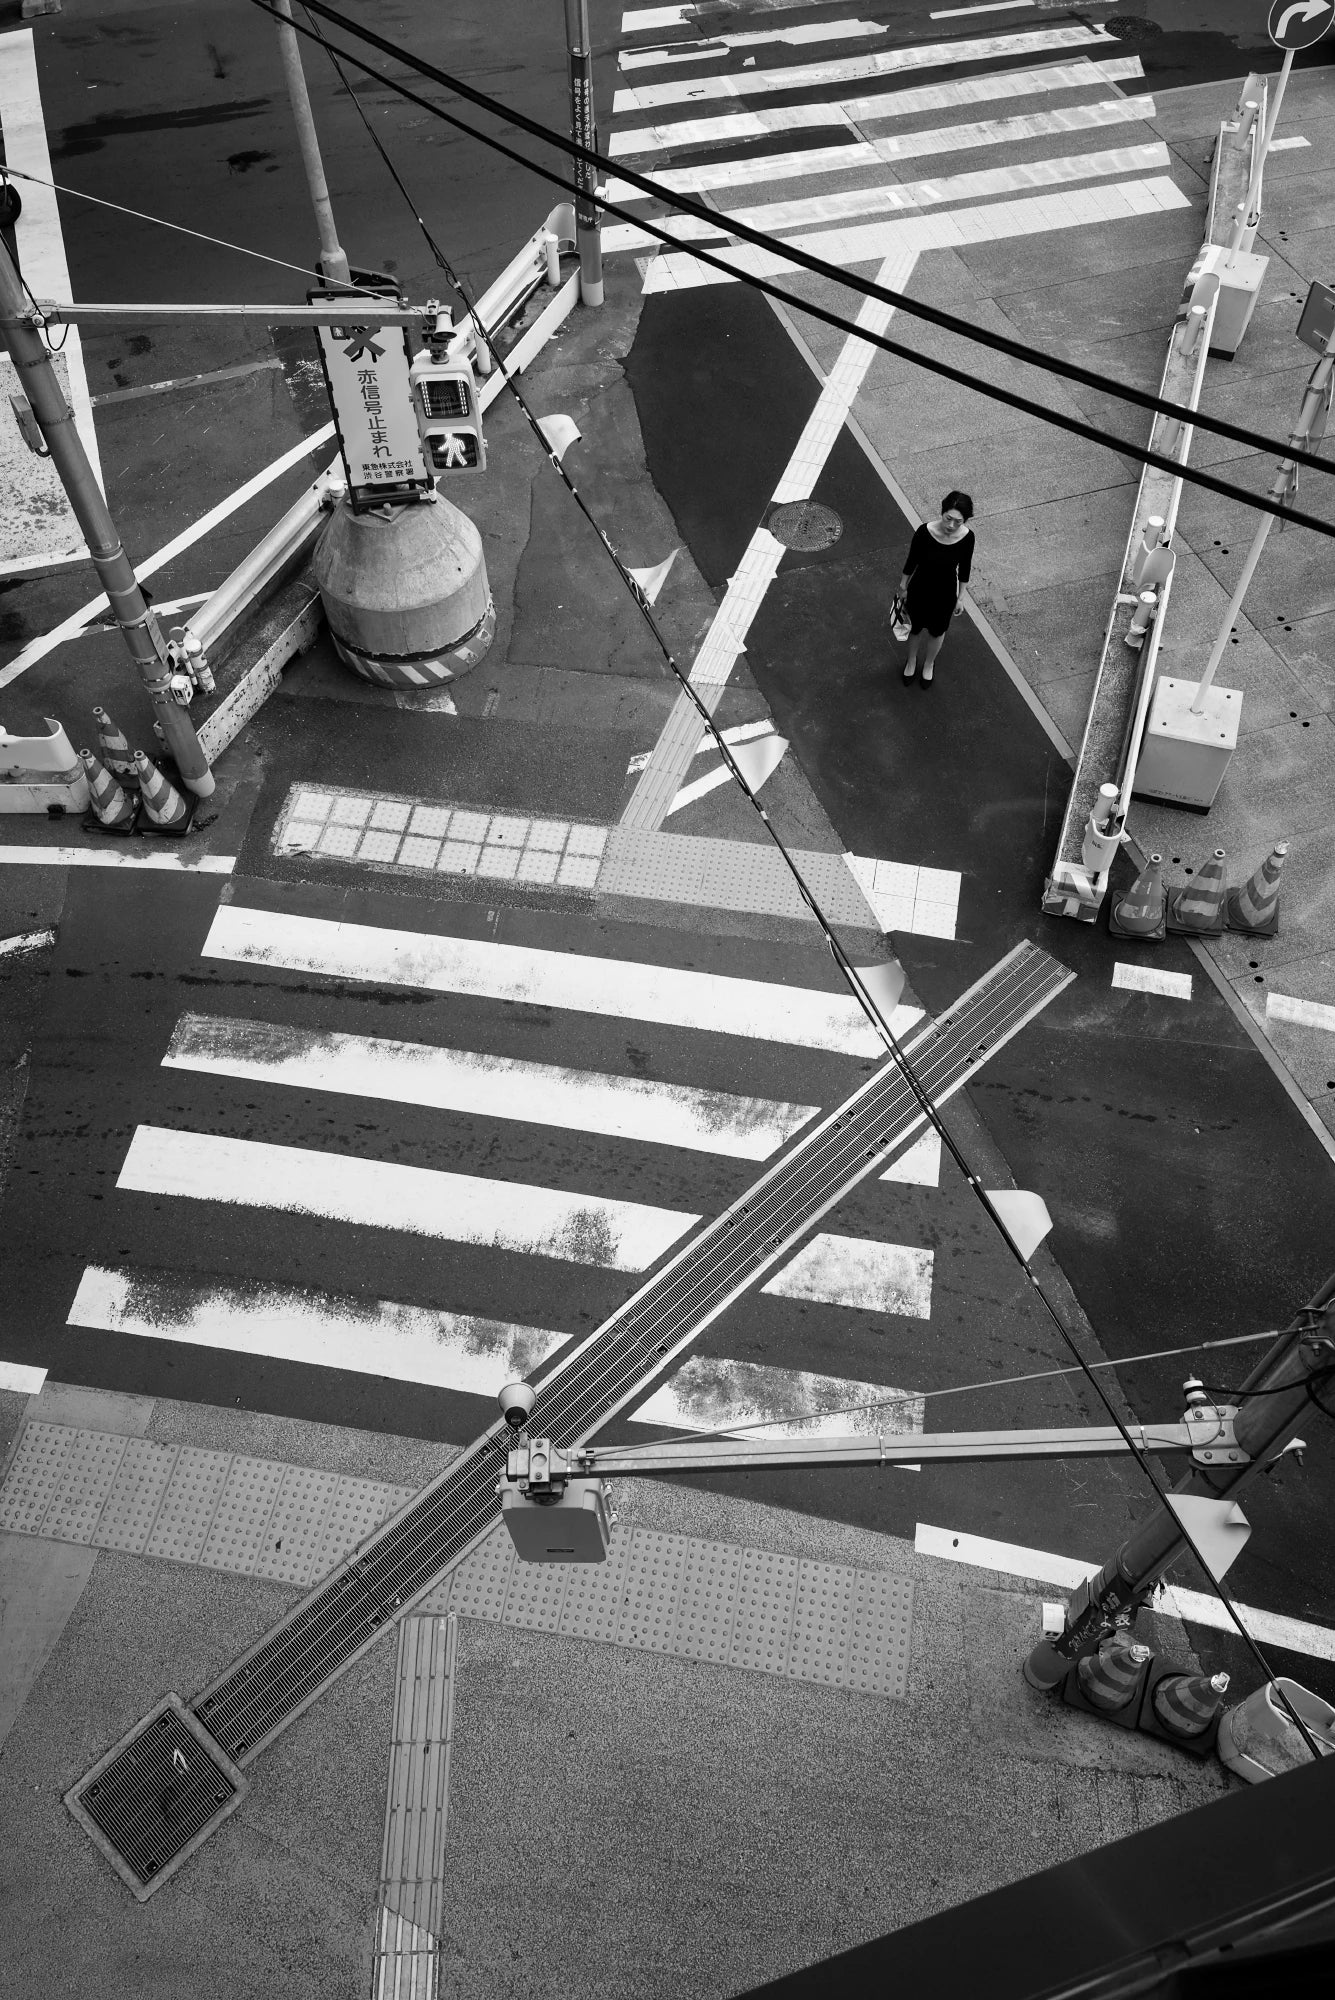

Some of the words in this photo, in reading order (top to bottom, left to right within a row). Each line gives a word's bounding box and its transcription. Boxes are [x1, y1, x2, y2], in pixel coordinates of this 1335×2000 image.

[357, 369, 392, 458] 赤信号止まれ
[362, 460, 413, 471] 東急株式会社
[363, 468, 414, 480] 渋谷警察署
